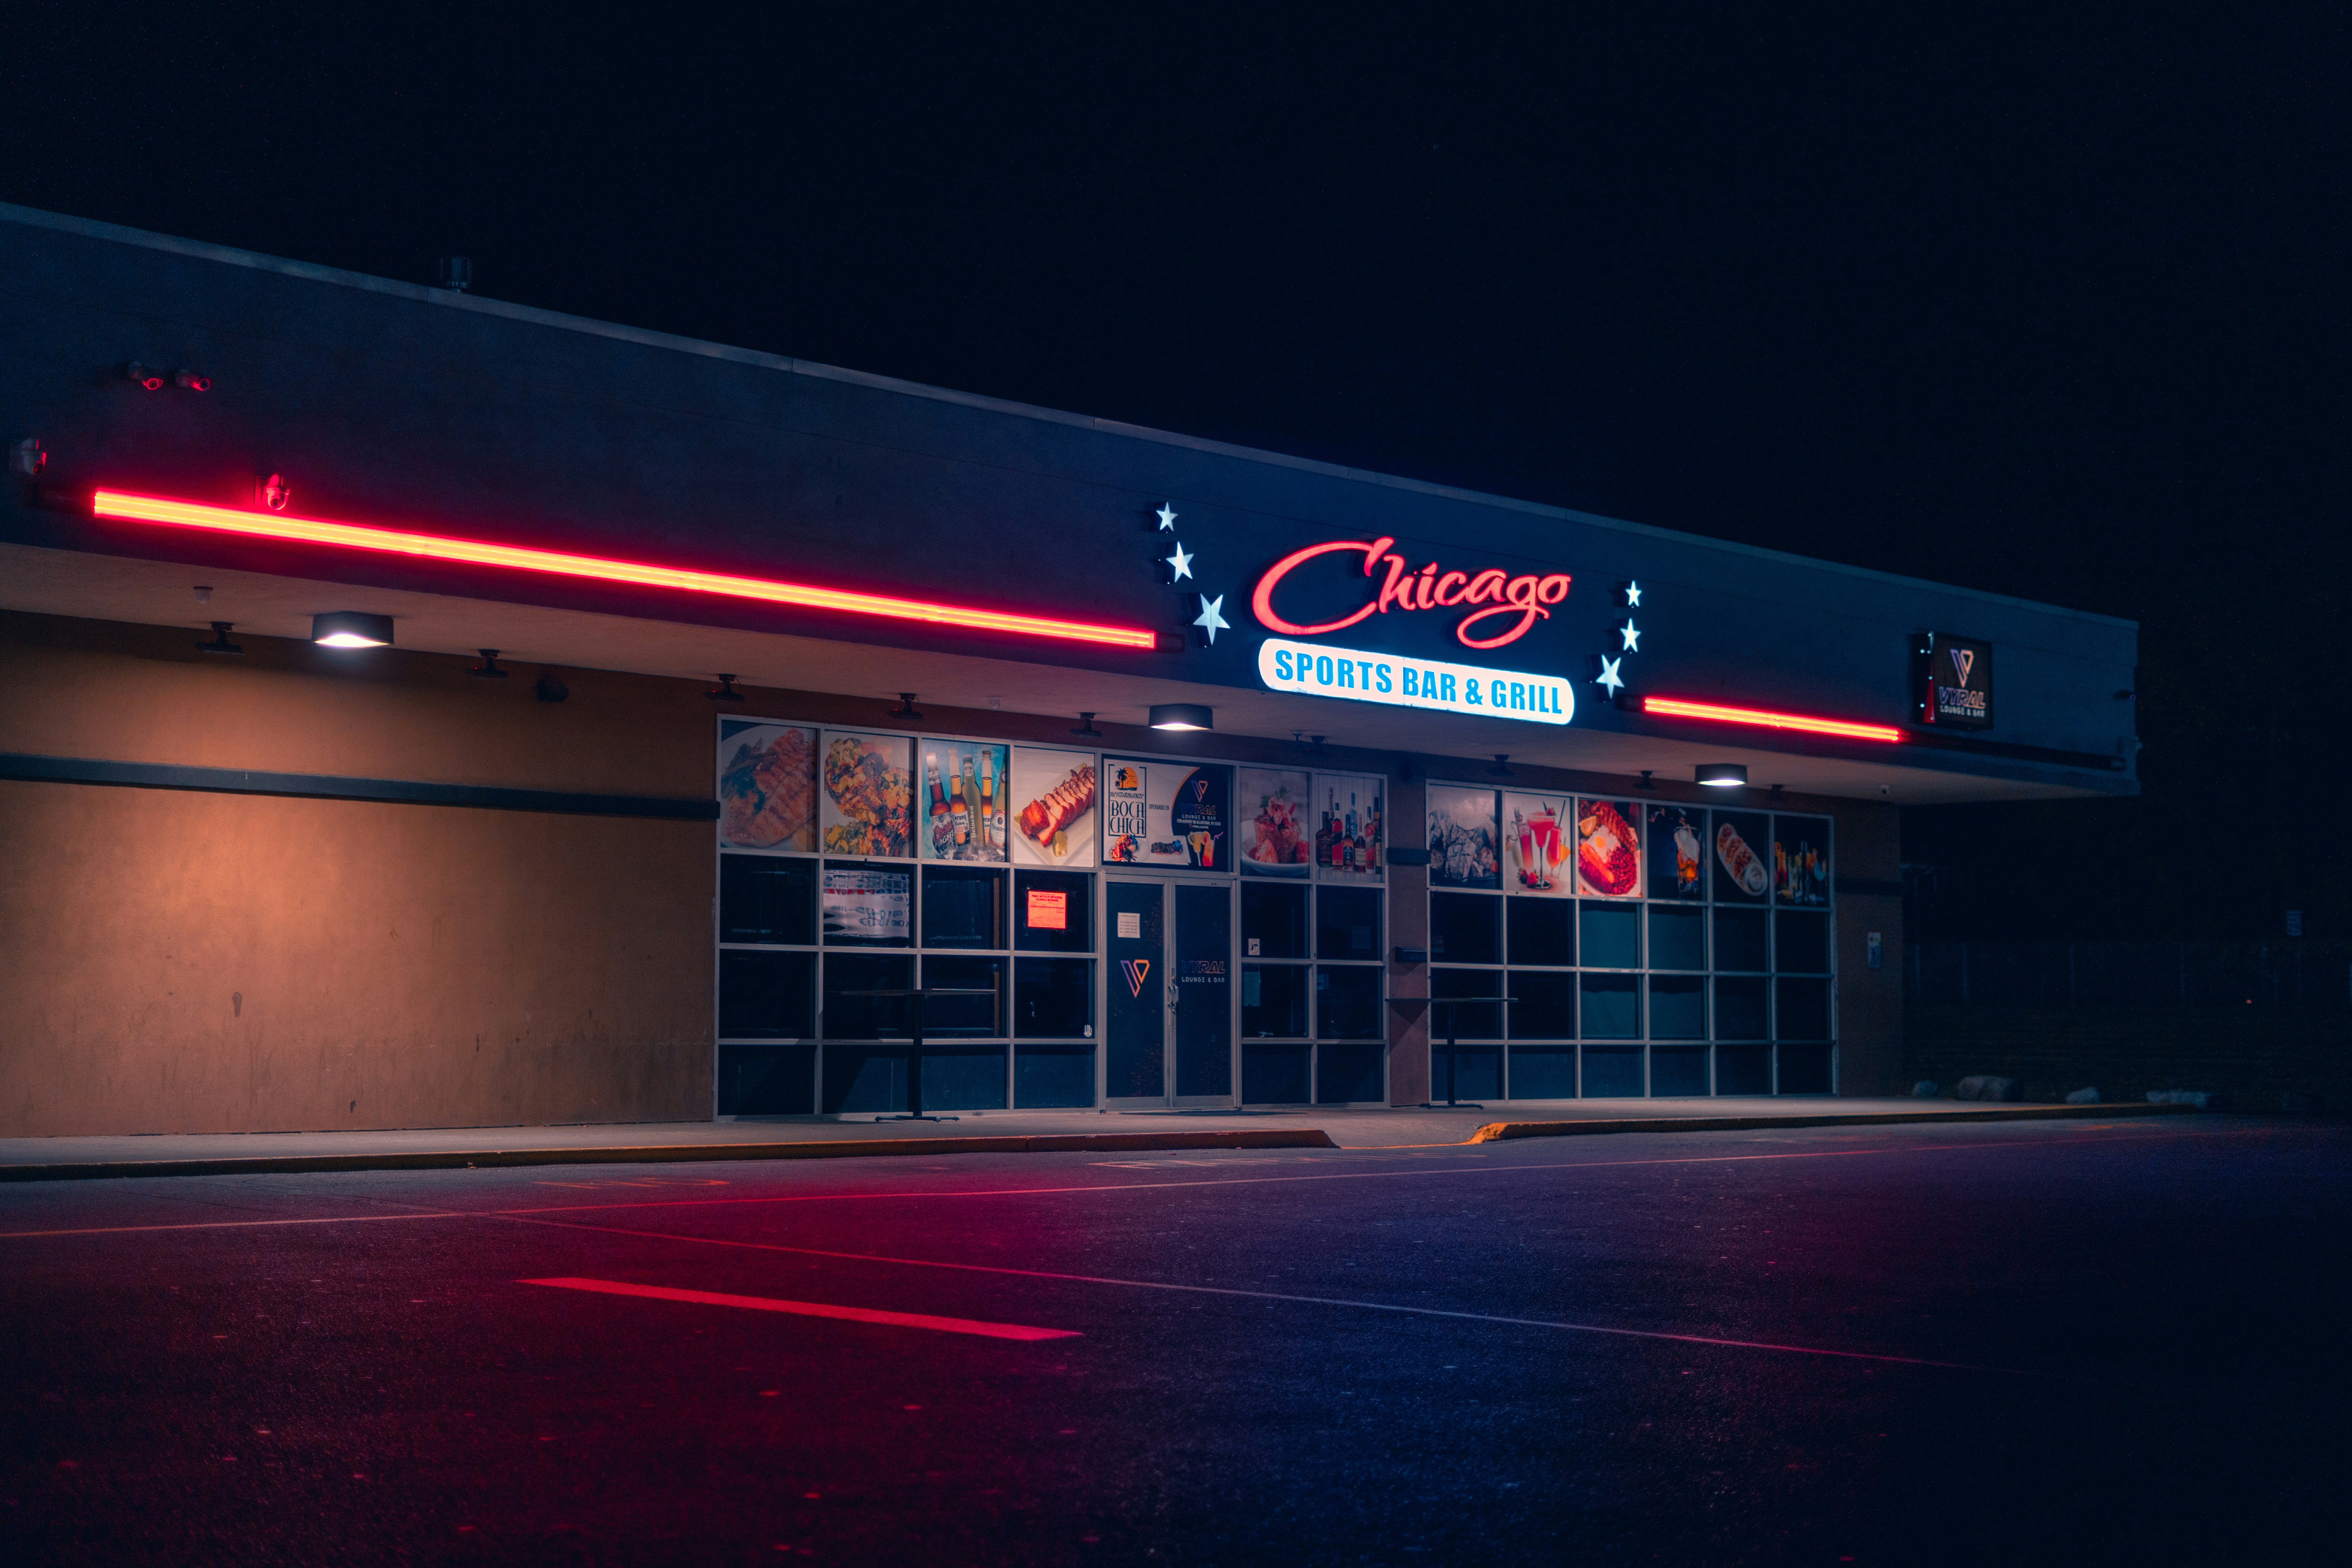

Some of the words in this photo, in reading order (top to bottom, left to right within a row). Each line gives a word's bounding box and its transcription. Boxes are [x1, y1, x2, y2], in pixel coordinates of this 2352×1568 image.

[1252, 536, 1571, 649] Chicago
[1275, 649, 1393, 693] SPORTS
[1402, 666, 1457, 702] BAR
[1465, 677, 1483, 705] &
[1491, 678, 1563, 715] GRILL
[1940, 705, 1965, 715] LOUNGE
[1110, 791, 1145, 799] RESTAURANTE
[1110, 800, 1145, 818] BOCA
[1110, 817, 1145, 835] CHICA
